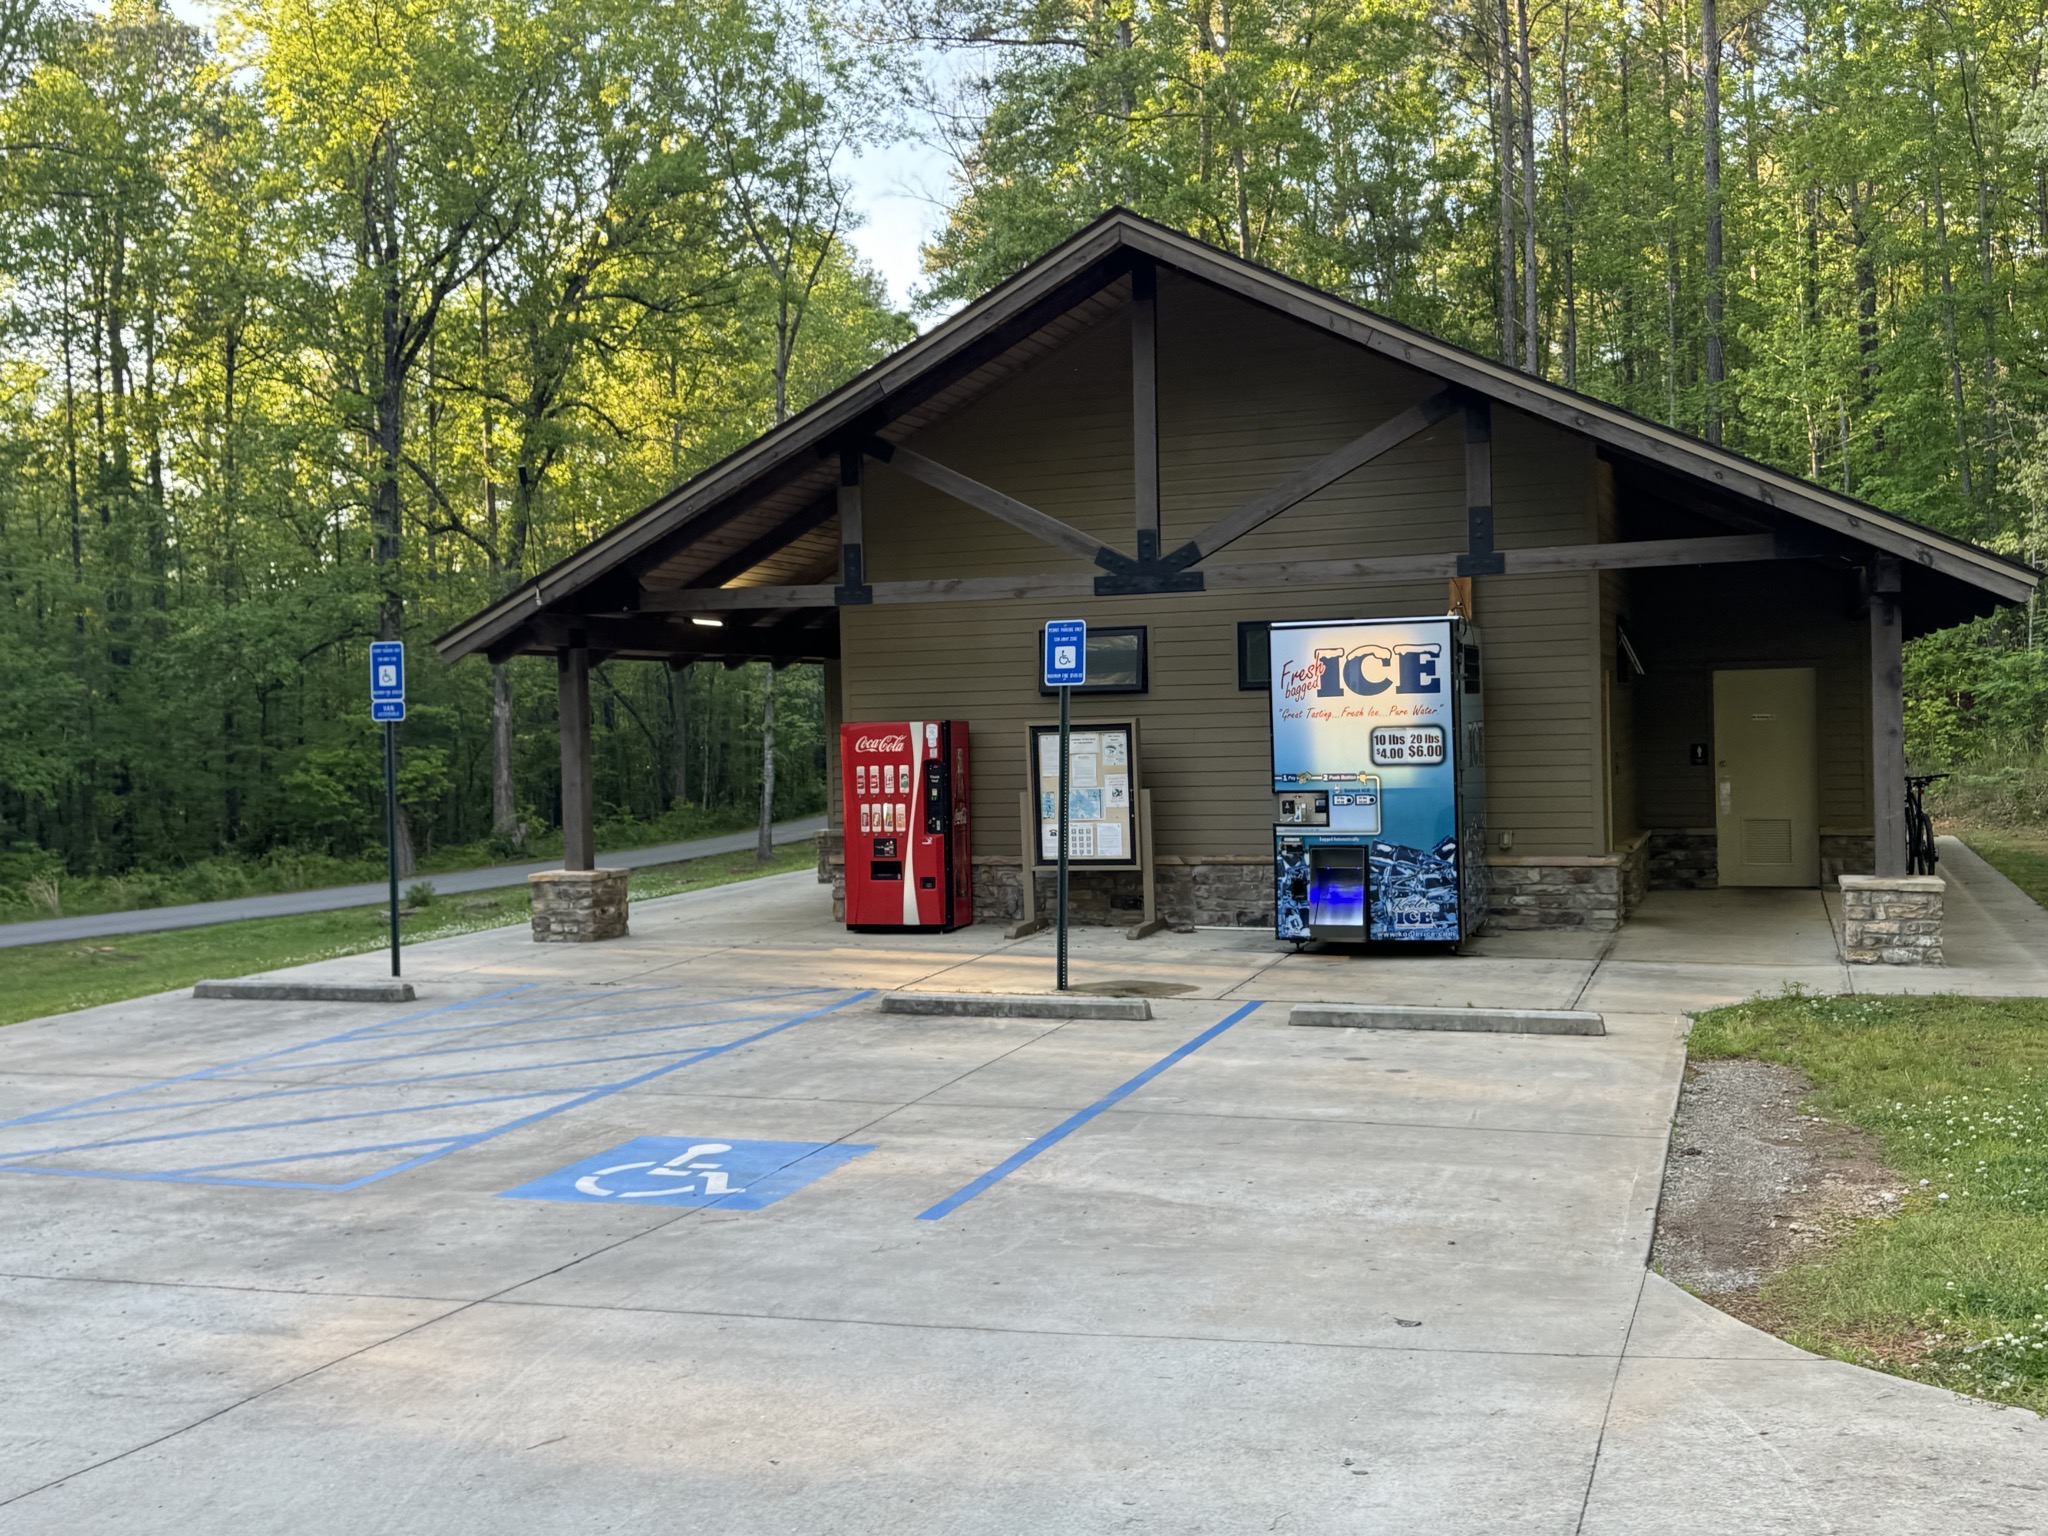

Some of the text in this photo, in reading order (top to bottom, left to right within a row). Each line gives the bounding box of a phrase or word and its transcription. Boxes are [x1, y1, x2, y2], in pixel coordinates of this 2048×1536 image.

[1280, 652, 1326, 690] Fresh
[1314, 642, 1442, 698] ICE
[1285, 674, 1319, 702] bagged
[855, 734, 907, 753] Coca-Cola
[1374, 734, 1406, 745] 10 lbs
[1410, 734, 1440, 744] 20 lbs
[1376, 748, 1404, 759] $4.00
[1408, 745, 1442, 758] $6.00
[1397, 911, 1432, 925] ICE
